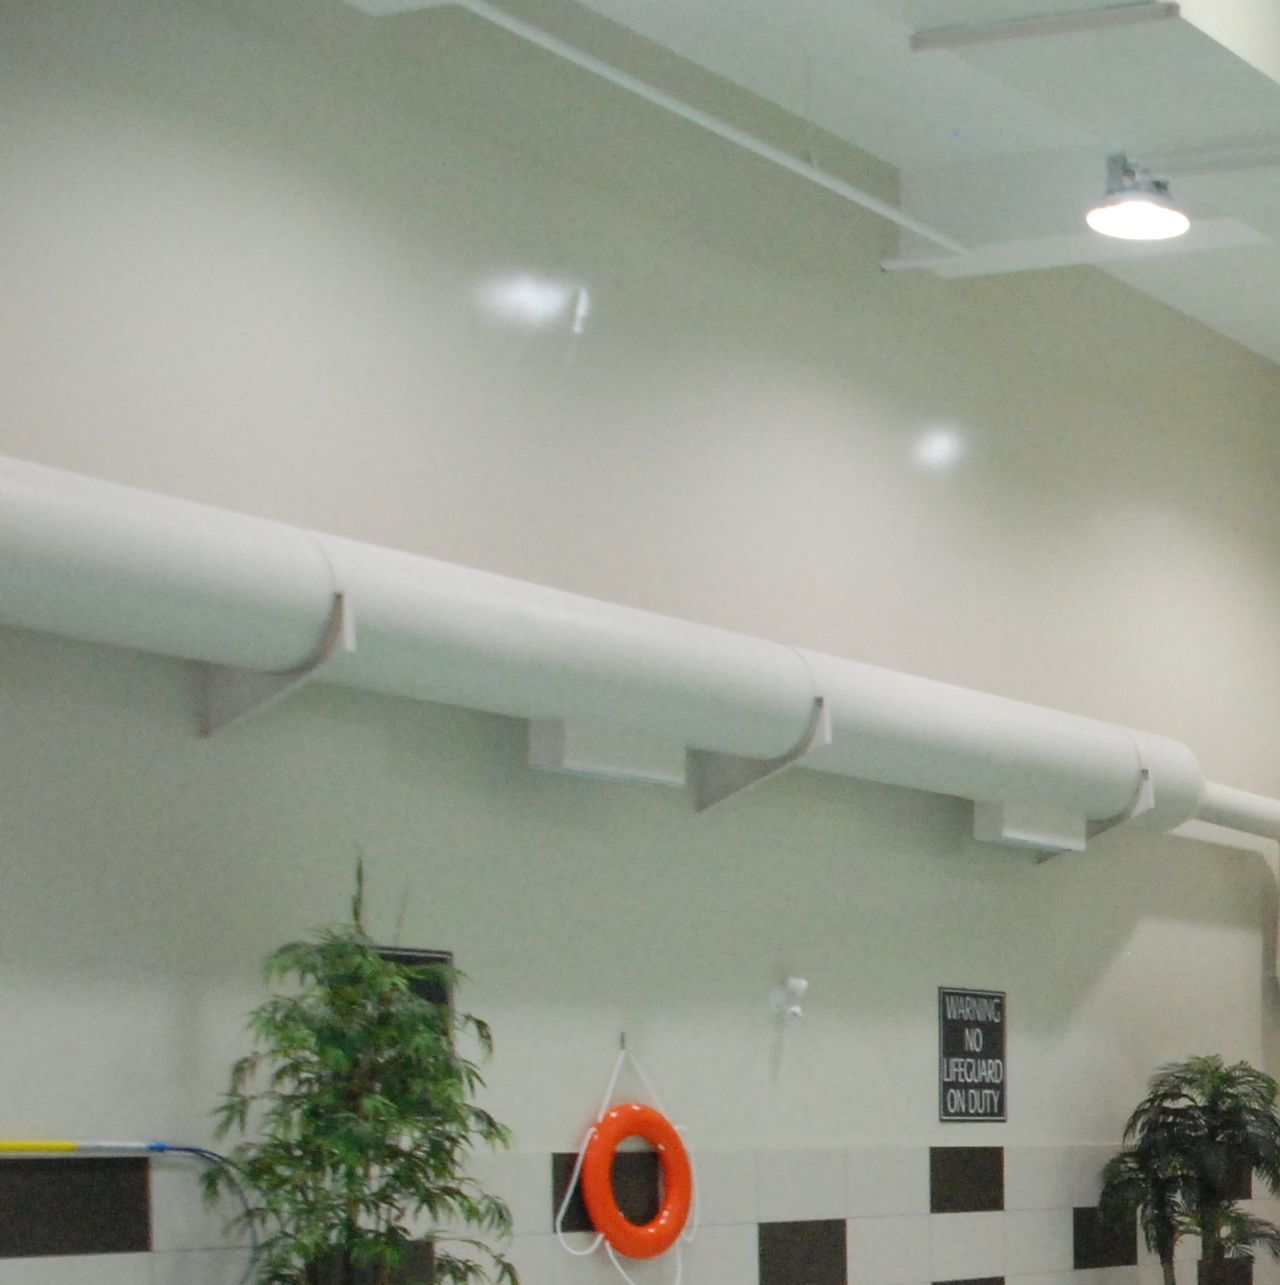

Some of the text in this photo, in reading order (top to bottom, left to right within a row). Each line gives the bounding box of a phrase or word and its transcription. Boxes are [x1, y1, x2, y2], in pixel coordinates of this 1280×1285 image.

[945, 995, 1001, 1022] WARNING
[965, 1028, 983, 1053] NO
[944, 1058, 1003, 1083] LIFEGUARD
[947, 1089, 1000, 1114] ON DUTY
